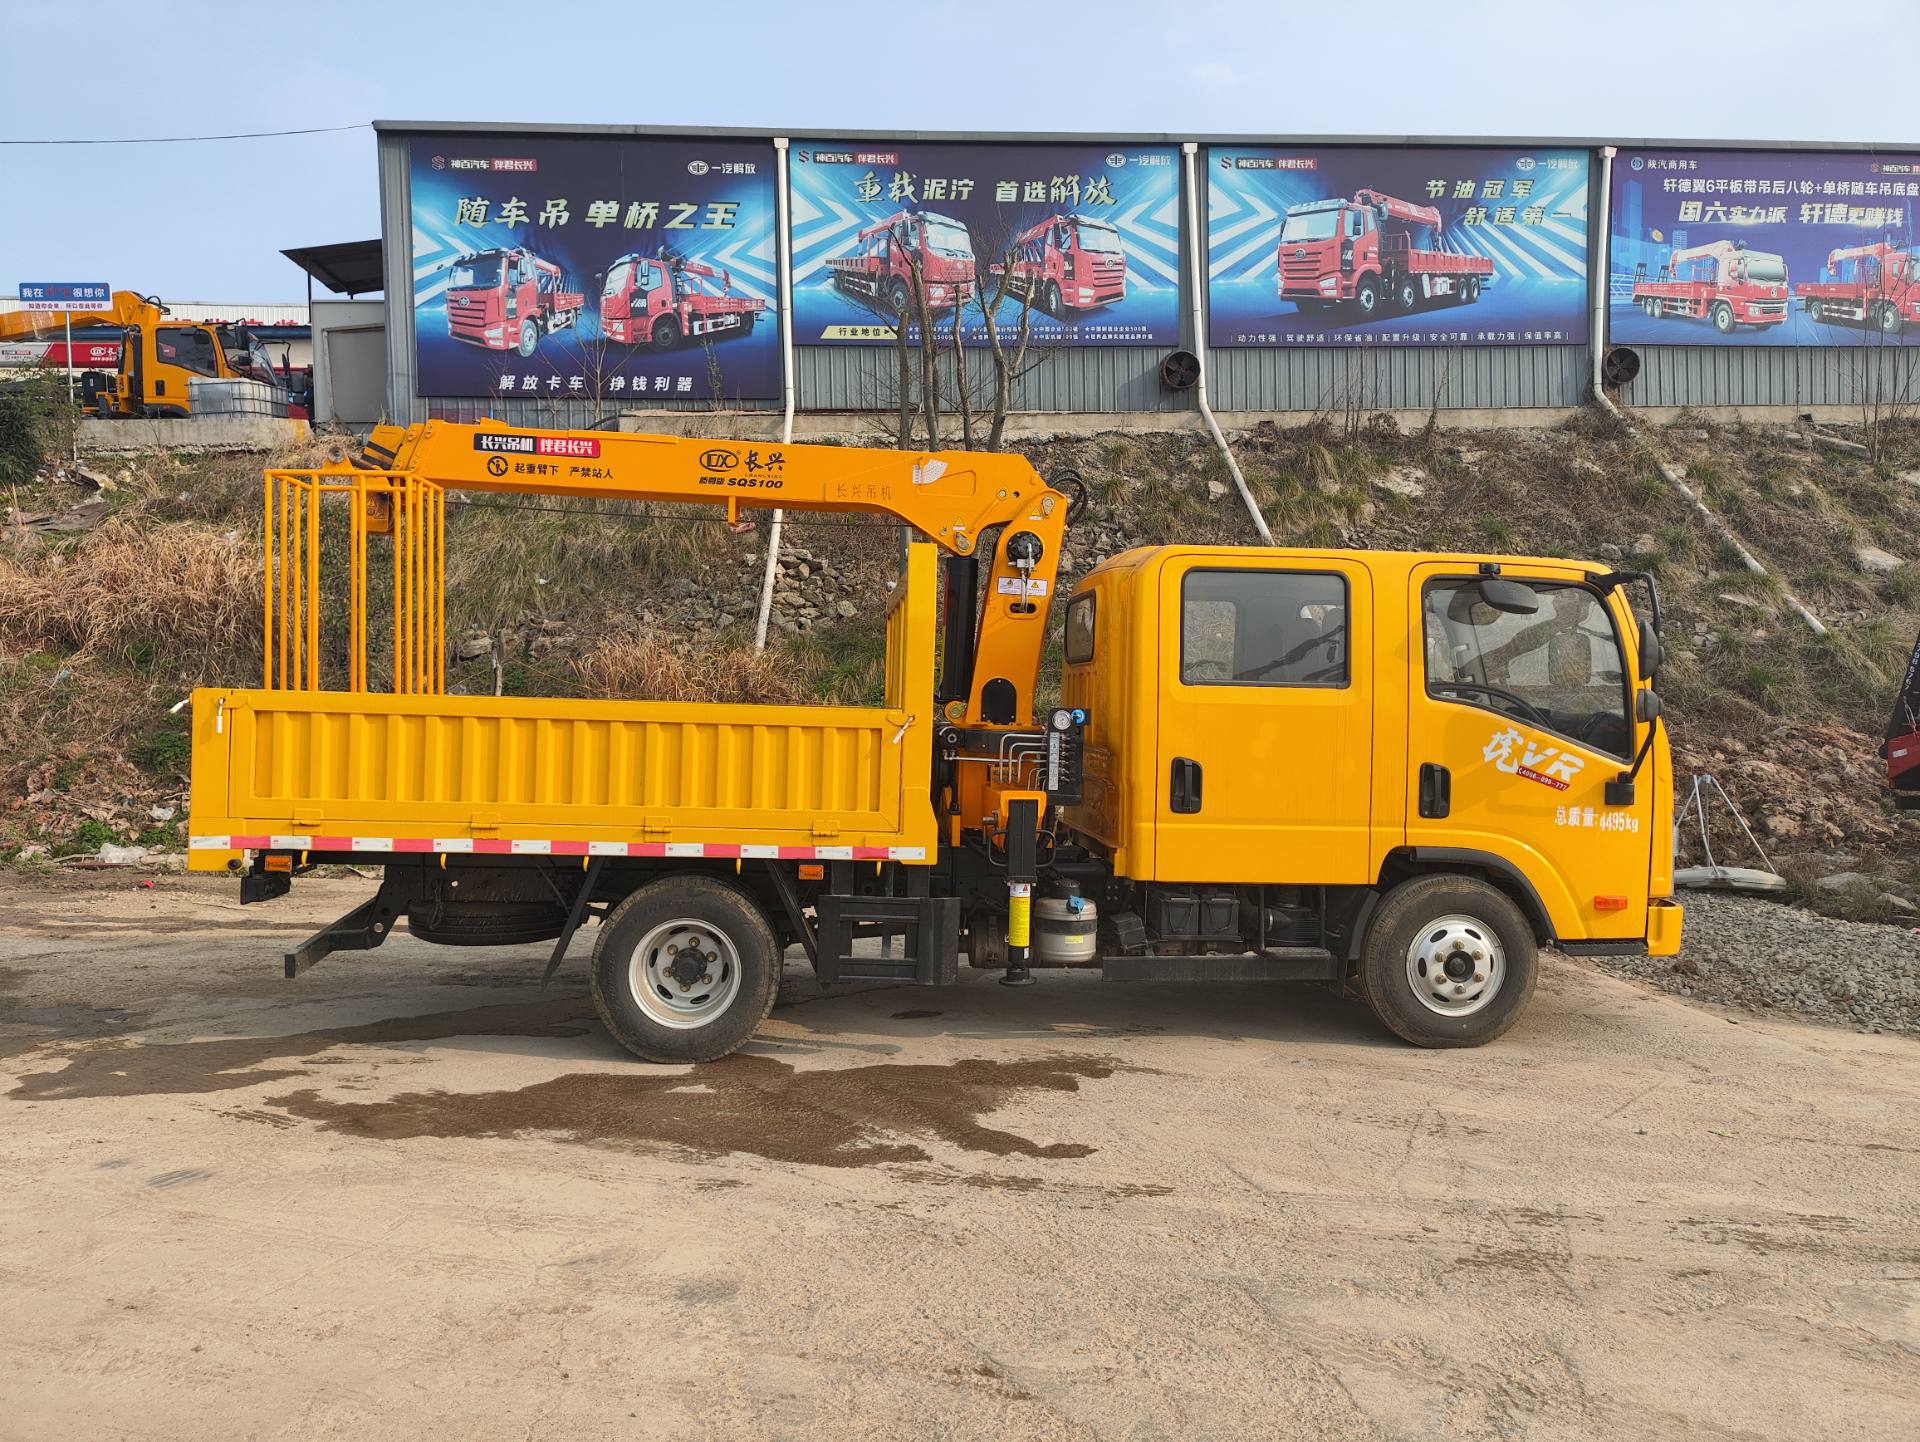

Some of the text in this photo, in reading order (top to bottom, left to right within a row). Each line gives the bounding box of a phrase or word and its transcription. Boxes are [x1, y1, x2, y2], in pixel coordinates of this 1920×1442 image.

[450, 159, 534, 171] 神百汽车 伴君长兴
[815, 152, 895, 165] 神百汽车 伴君长兴
[1128, 155, 1171, 166] 一汽解放
[1238, 158, 1274, 169] 神百汽车
[1537, 158, 1578, 169] 一汽解放
[1647, 159, 1697, 170] 陕汽商用车
[711, 162, 756, 175] 一汽解放
[852, 171, 1118, 206] 重载泥泞 首选解放
[1425, 179, 1535, 200] 节油冠军
[453, 196, 741, 231] 随车吊 单桥之王
[1462, 206, 1572, 227] 舒适第一
[1678, 200, 1904, 228] 国六实力派 轩德更赚钱
[838, 327, 881, 337] 行业地位
[1237, 332, 1562, 343] 动力性强 驾驶舒适 环保省油 配置升级 安全可靠 承载力强 保值率高
[498, 375, 694, 392] 解放卡车 挣钱利器
[480, 435, 593, 455] 长兴吊机 伴君长兴
[743, 450, 787, 473] 长兴
[514, 462, 614, 479] 起重臂下 严禁站人
[727, 477, 784, 489] SQS100
[835, 484, 892, 501] 长兴吊机
